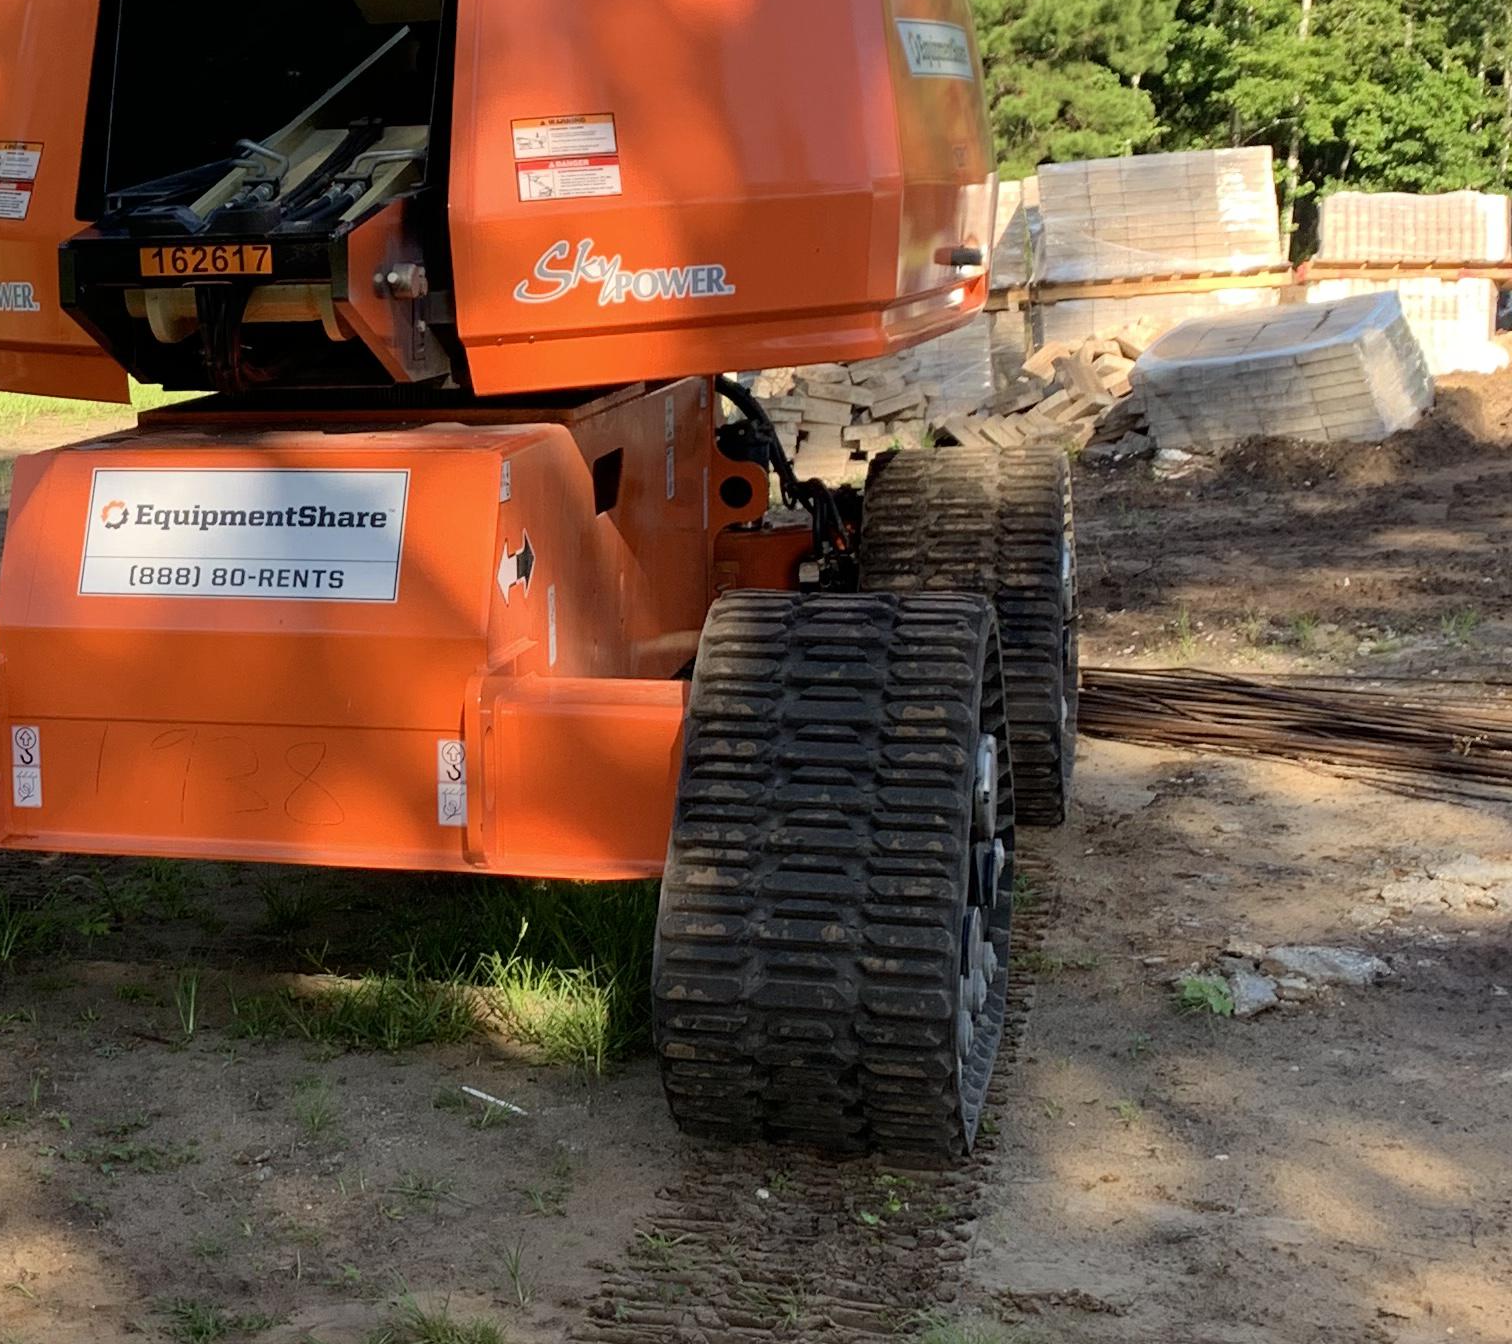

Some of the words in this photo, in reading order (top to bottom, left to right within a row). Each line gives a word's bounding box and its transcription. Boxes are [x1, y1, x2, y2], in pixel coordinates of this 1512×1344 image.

[151, 244, 268, 274] 162617
[134, 504, 387, 531] EquipmentShare
[129, 565, 200, 588] (888)
[211, 567, 344, 589] 80-RENTS
